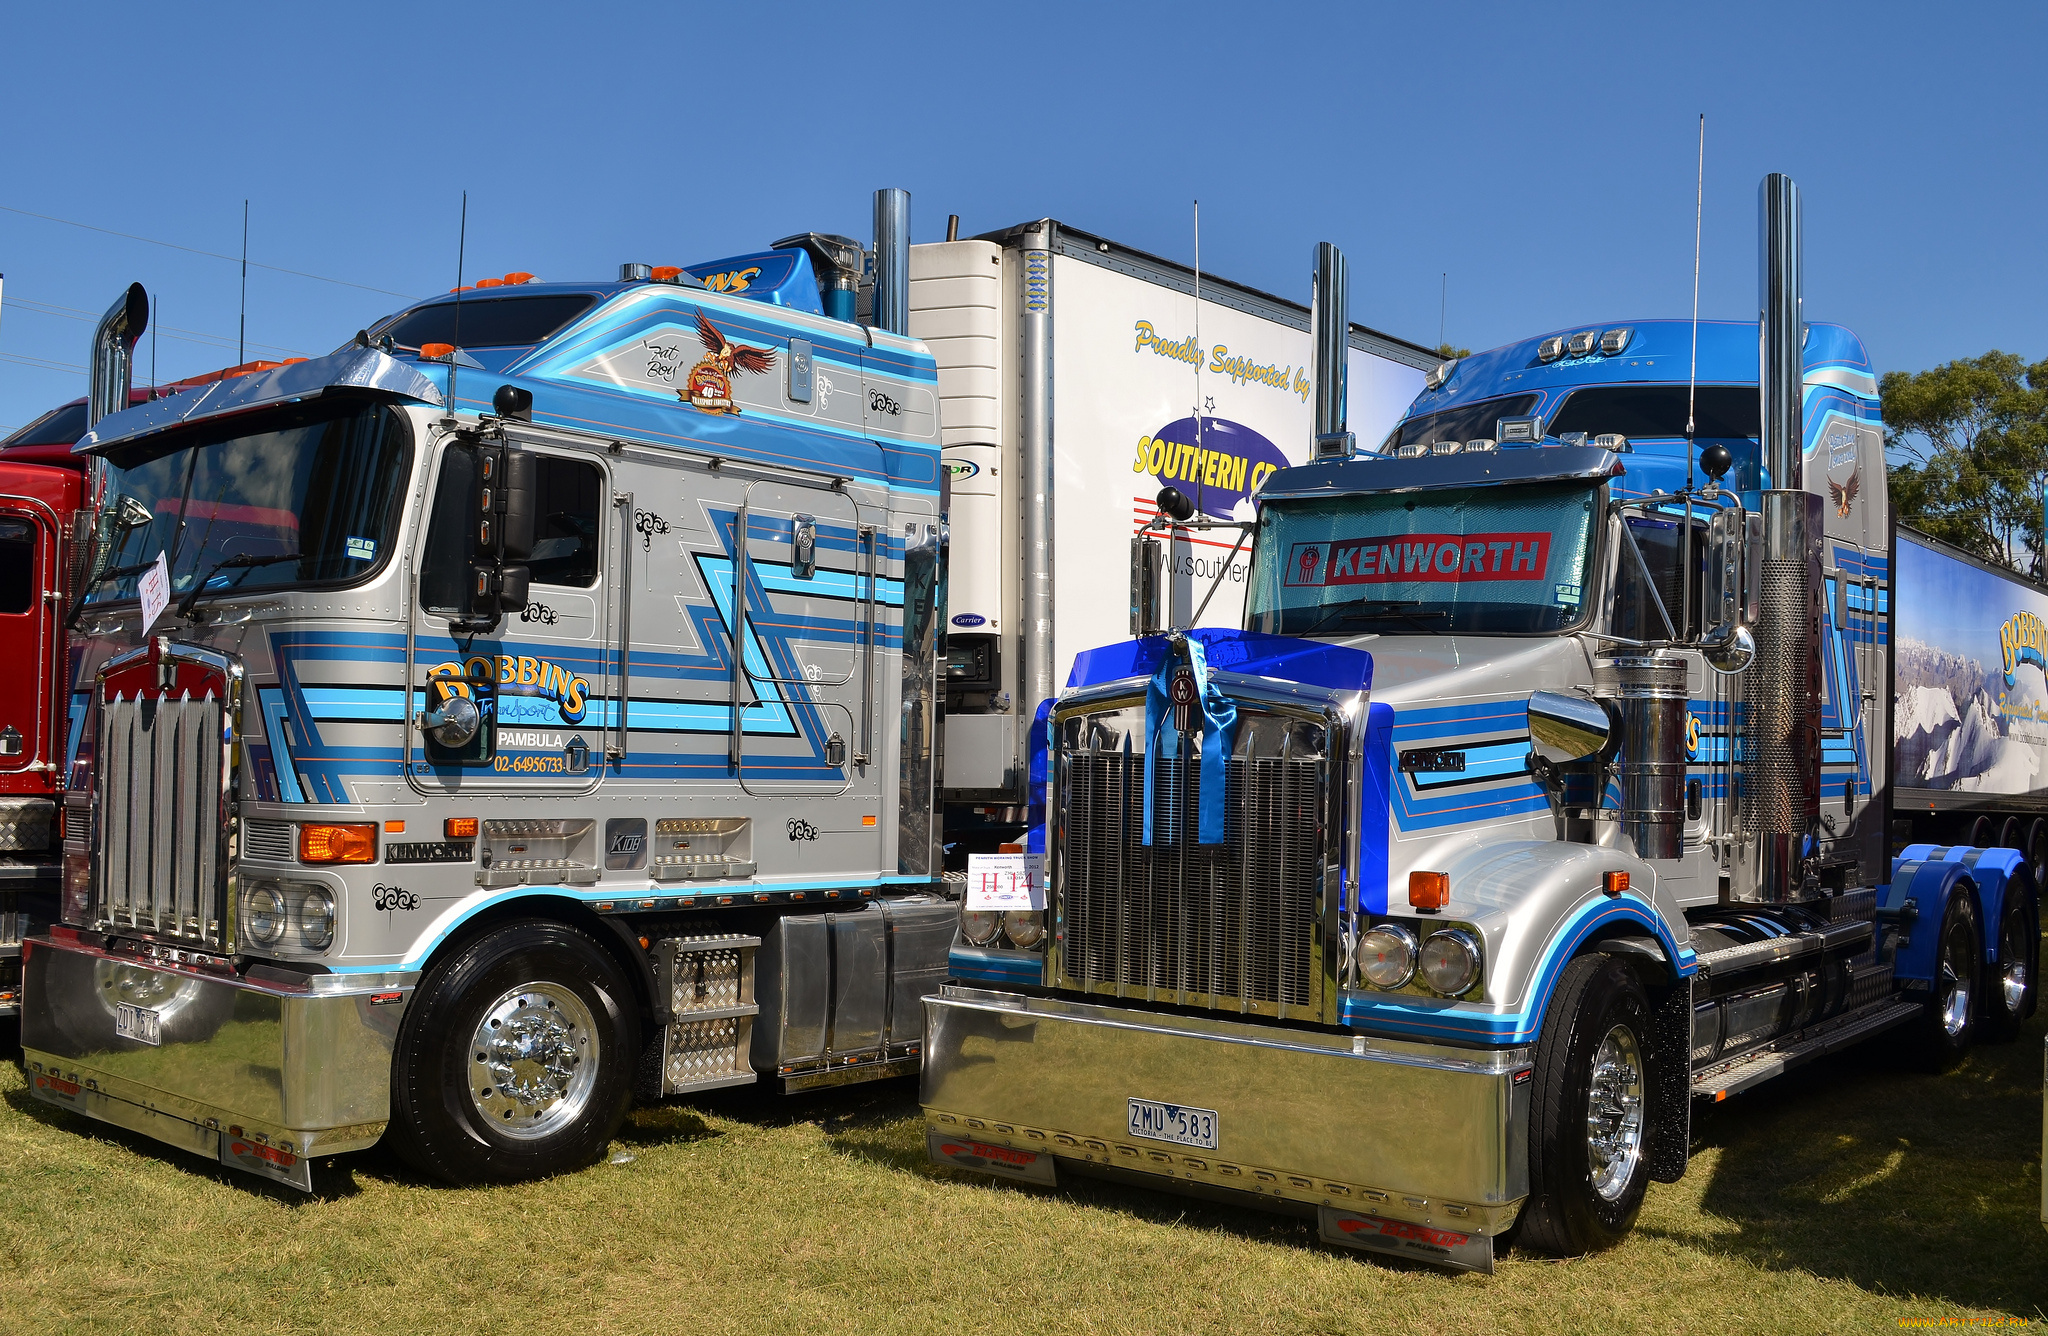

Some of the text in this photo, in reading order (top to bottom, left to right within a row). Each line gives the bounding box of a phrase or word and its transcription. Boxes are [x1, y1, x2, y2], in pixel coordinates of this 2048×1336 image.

[1135, 320, 1311, 403] Proudly Supported by
[702, 386, 714, 398] 40
[1133, 436, 1248, 492] SOUTHERN
[1333, 541, 1539, 577] KENWORTH
[955, 616, 982, 624] Carrier
[426, 656, 590, 724] BOBBINS
[498, 732, 563, 748] PAMBULA
[494, 756, 562, 772] 02-64956733
[1399, 751, 1466, 768] KENWORTH
[386, 842, 474, 861] KENWORTH
[611, 834, 642, 852] K108
[981, 873, 1033, 892] H 14
[1131, 1104, 1212, 1139] ZMU 583
[1132, 1129, 1156, 1137] VICTORIA
